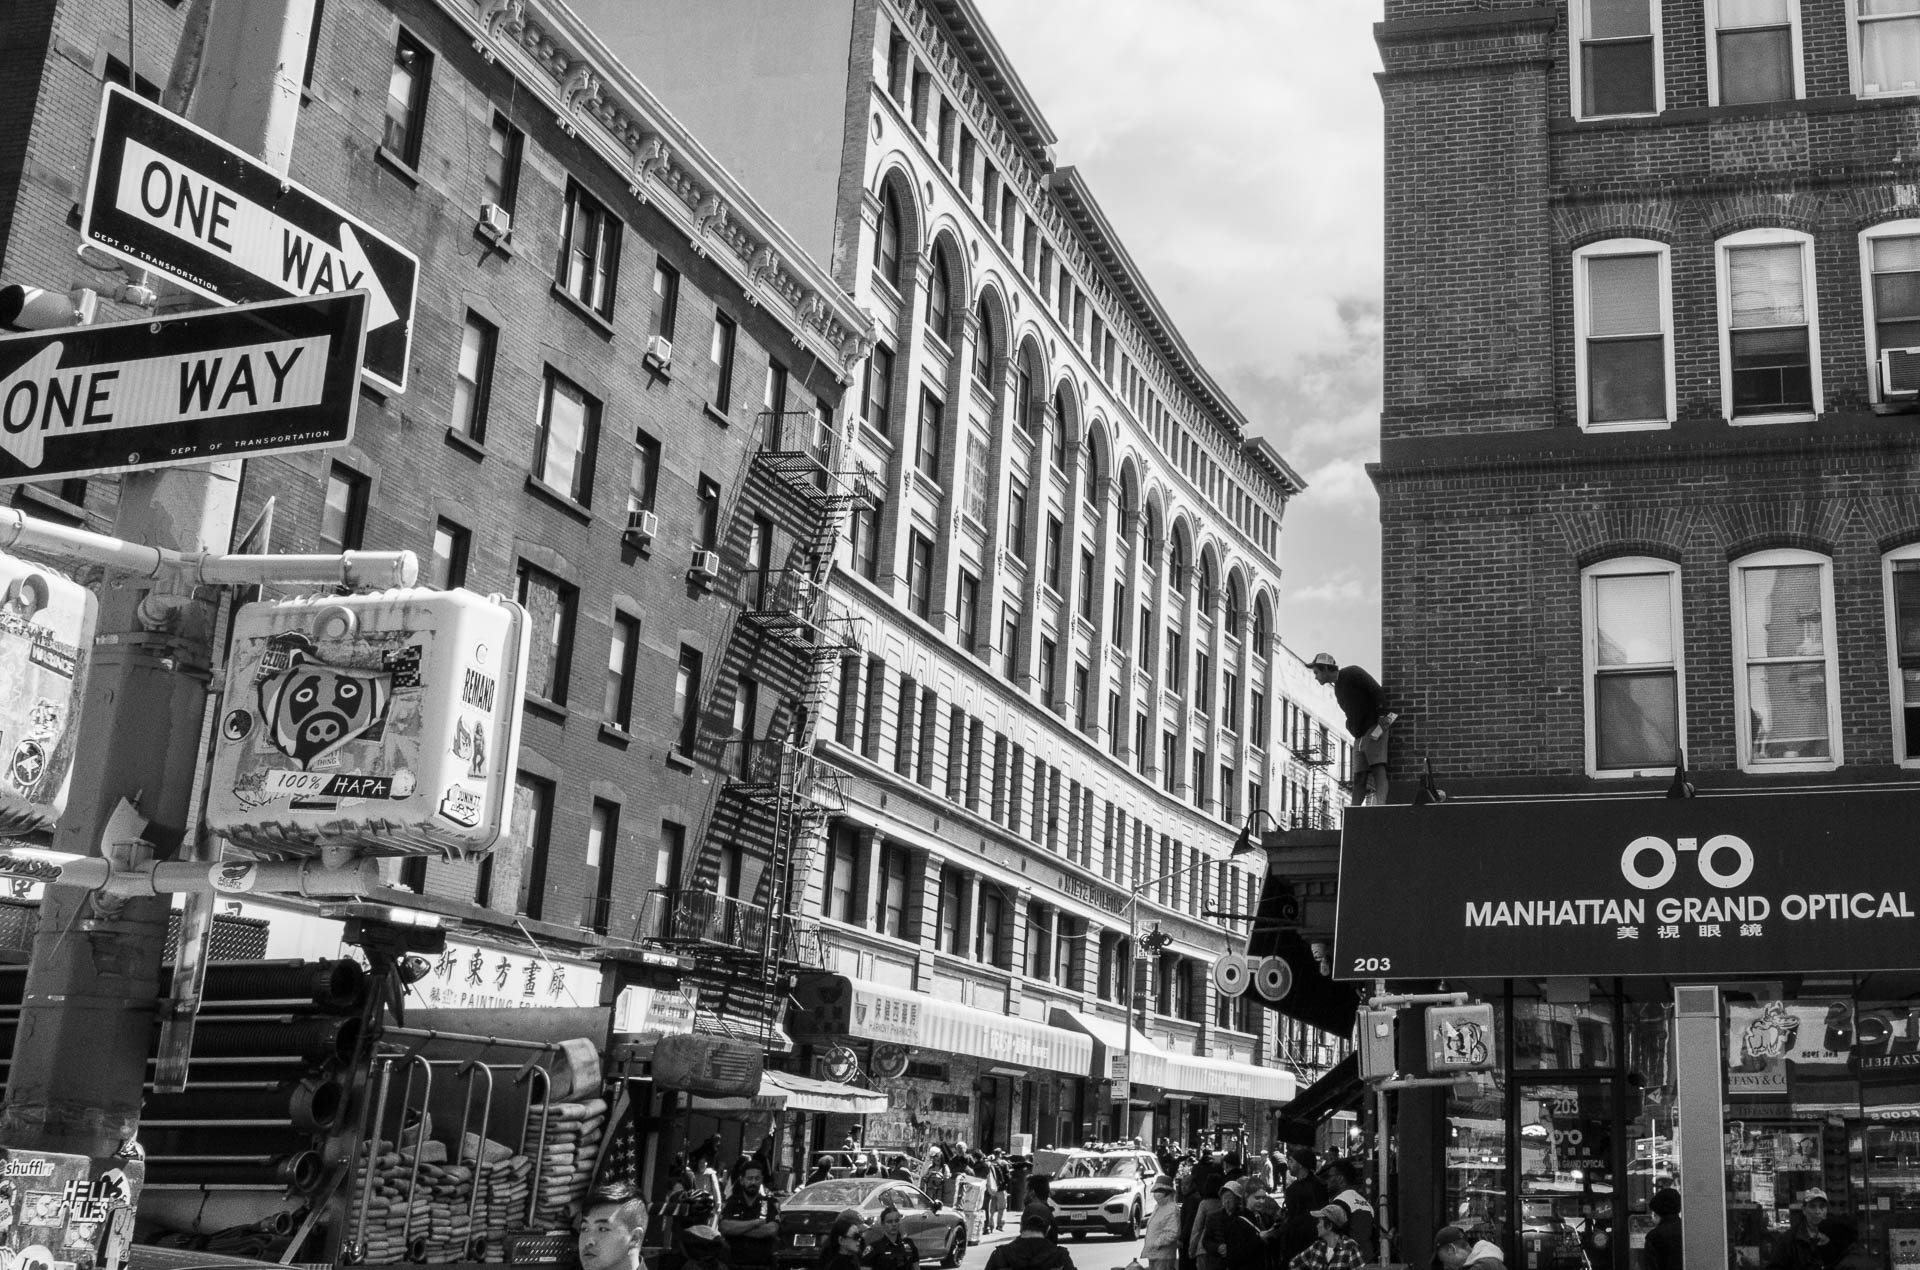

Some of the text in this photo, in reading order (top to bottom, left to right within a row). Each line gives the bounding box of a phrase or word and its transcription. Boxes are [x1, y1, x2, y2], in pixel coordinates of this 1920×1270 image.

[140, 160, 365, 295] ONE WAY
[94, 230, 219, 293] DEPT OF TRANSPORTATION
[2, 346, 305, 435] ONE WAY
[170, 430, 330, 456] DEPT OF TRANSPORTATION
[277, 773, 387, 796] 100% HAPA
[1465, 892, 1915, 927] MANHATTAN GRAND OPTICAL
[1617, 923, 1763, 939] 美視眼鏡
[1353, 957, 1391, 972] 203
[1553, 1100, 1579, 1114] 203
[1561, 1159, 1581, 1169] GRAND
[1582, 1159, 1605, 1169] OPTICAL
